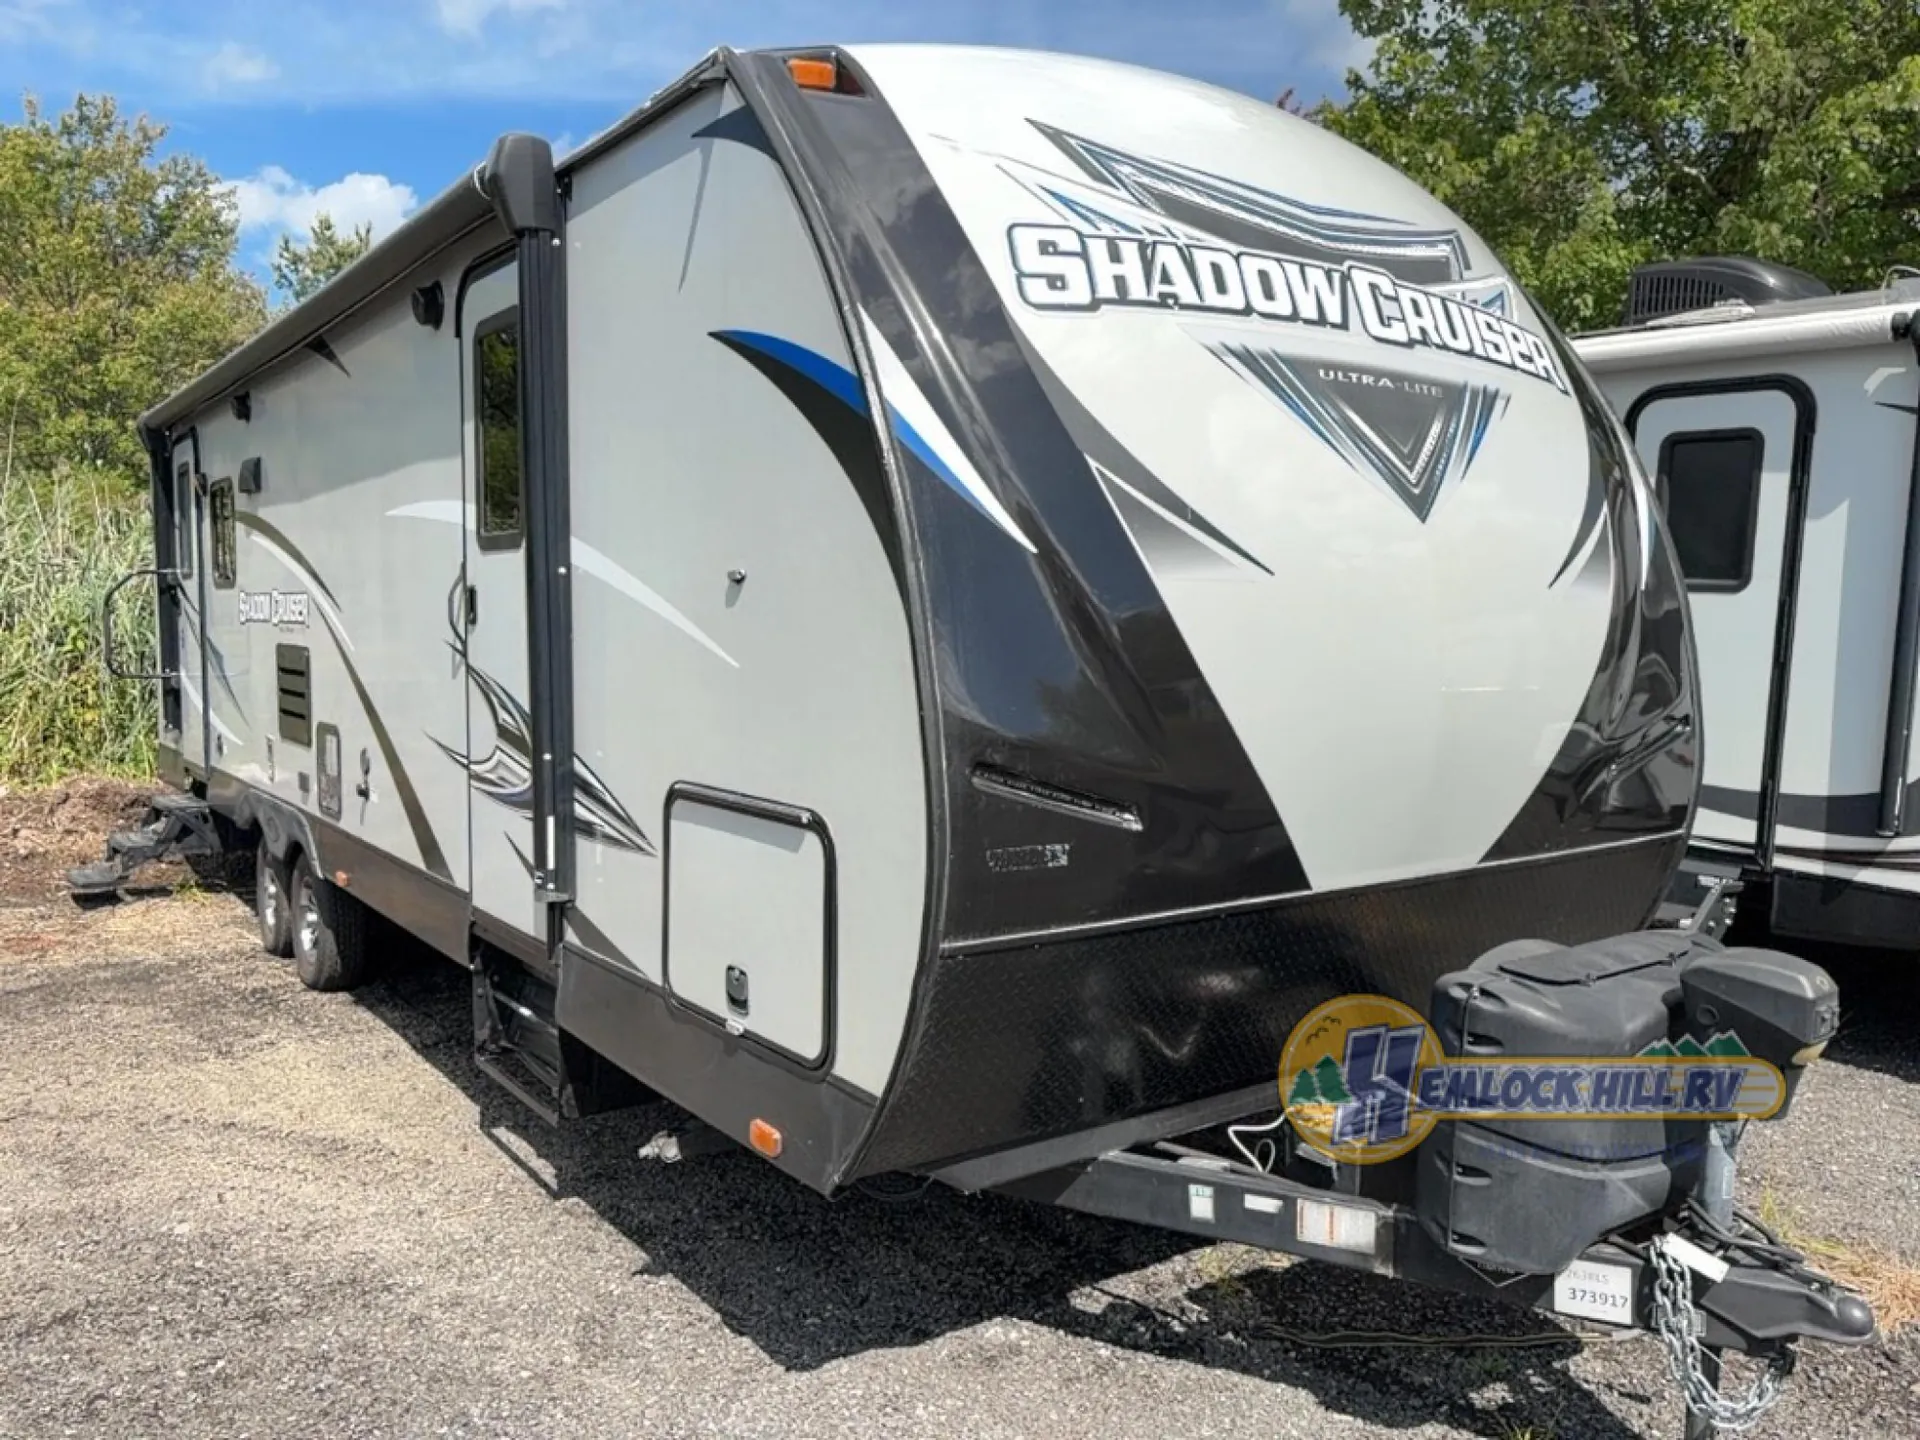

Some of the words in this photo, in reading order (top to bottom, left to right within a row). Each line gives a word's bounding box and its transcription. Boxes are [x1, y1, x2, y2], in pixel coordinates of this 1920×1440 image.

[1007, 223, 1349, 331] SHADOW
[1347, 264, 1571, 397] CRUISER
[1318, 368, 1444, 398] ULTRA-LITE
[1568, 1287, 1628, 1309] 373917
